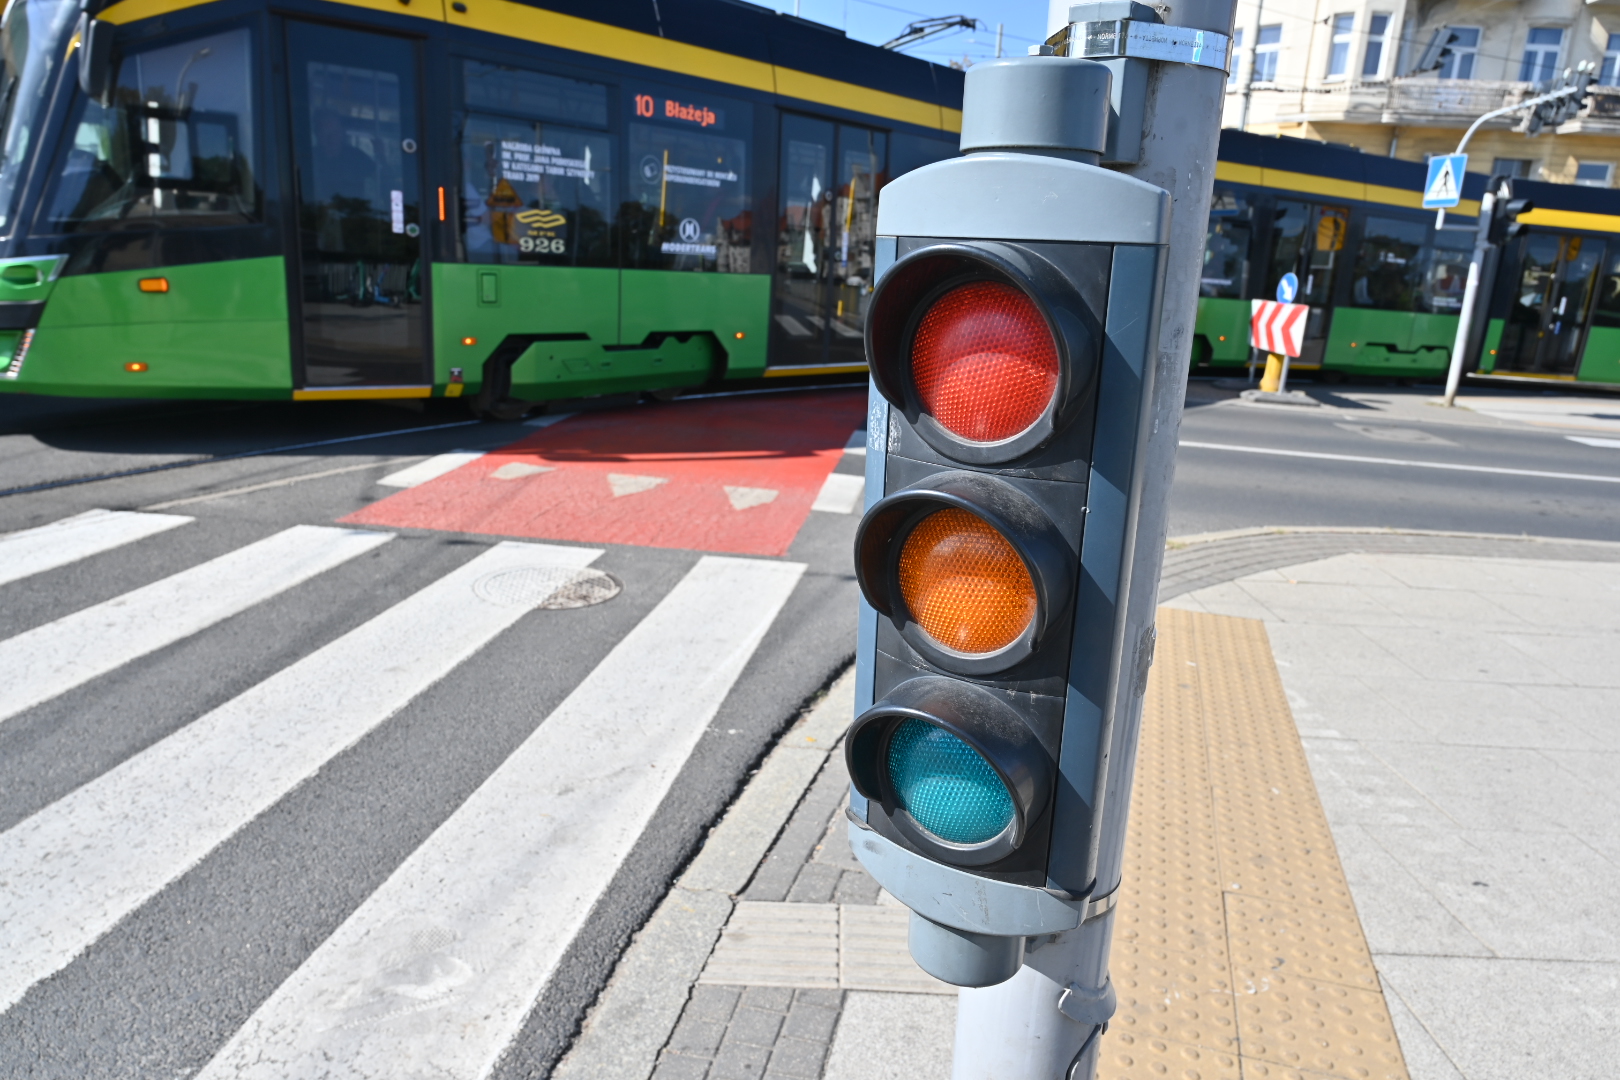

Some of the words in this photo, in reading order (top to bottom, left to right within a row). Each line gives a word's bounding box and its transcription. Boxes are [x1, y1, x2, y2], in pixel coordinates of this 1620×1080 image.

[635, 94, 654, 117] 10
[665, 100, 716, 127] Błażeja
[519, 236, 565, 254] 926
